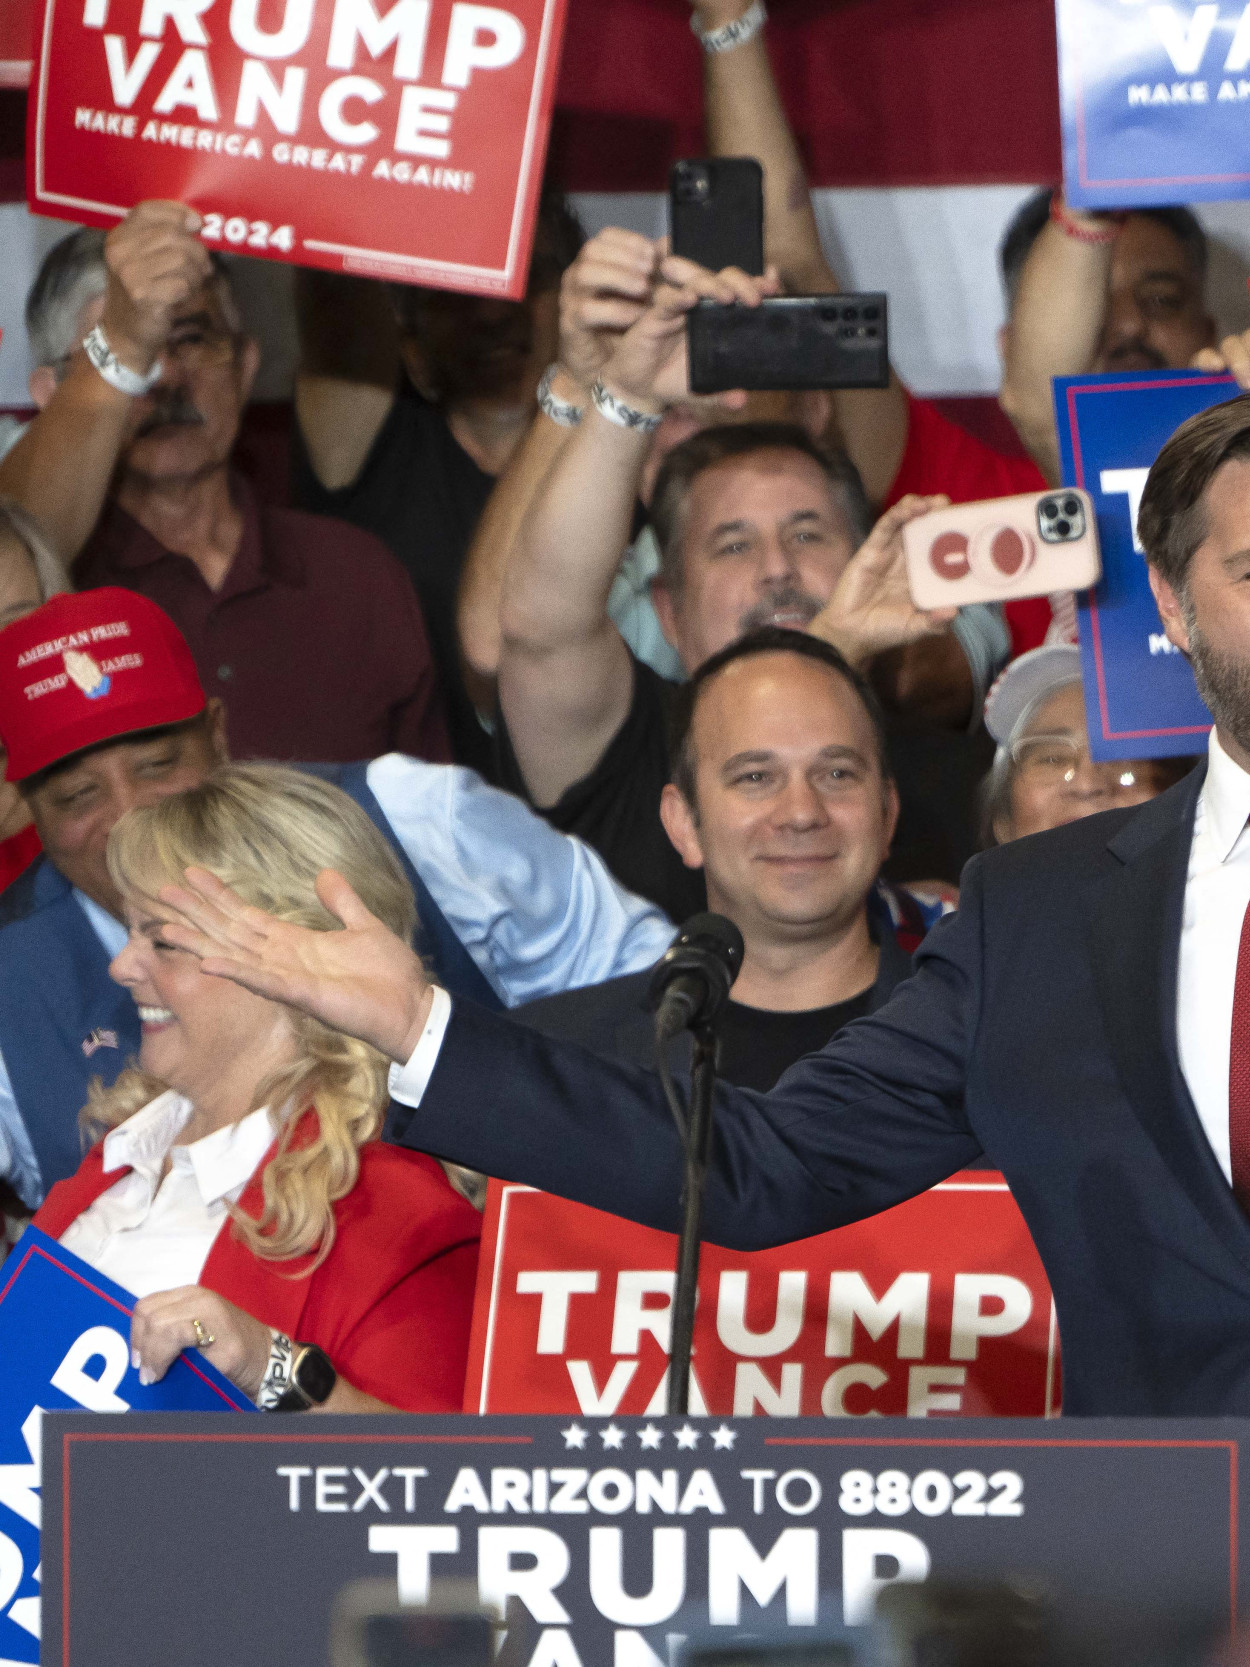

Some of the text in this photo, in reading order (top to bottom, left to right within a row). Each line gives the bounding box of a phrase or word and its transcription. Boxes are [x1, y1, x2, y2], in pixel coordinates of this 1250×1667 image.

[103, 34, 460, 160] VANCE
[1127, 81, 1209, 107] MAKE
[74, 106, 475, 194] MAKE AMERICA GREAT AGAIN!
[200, 211, 295, 252] 2024
[17, 621, 130, 669] AMERICAN PRIDE
[24, 672, 69, 700] TRUMP
[515, 1269, 1033, 1361] TRUMP
[566, 1360, 966, 1418] VANCE
[276, 1465, 1025, 1517] TEXT ARIZONA TO 88022
[368, 1525, 931, 1627] TRUMP
